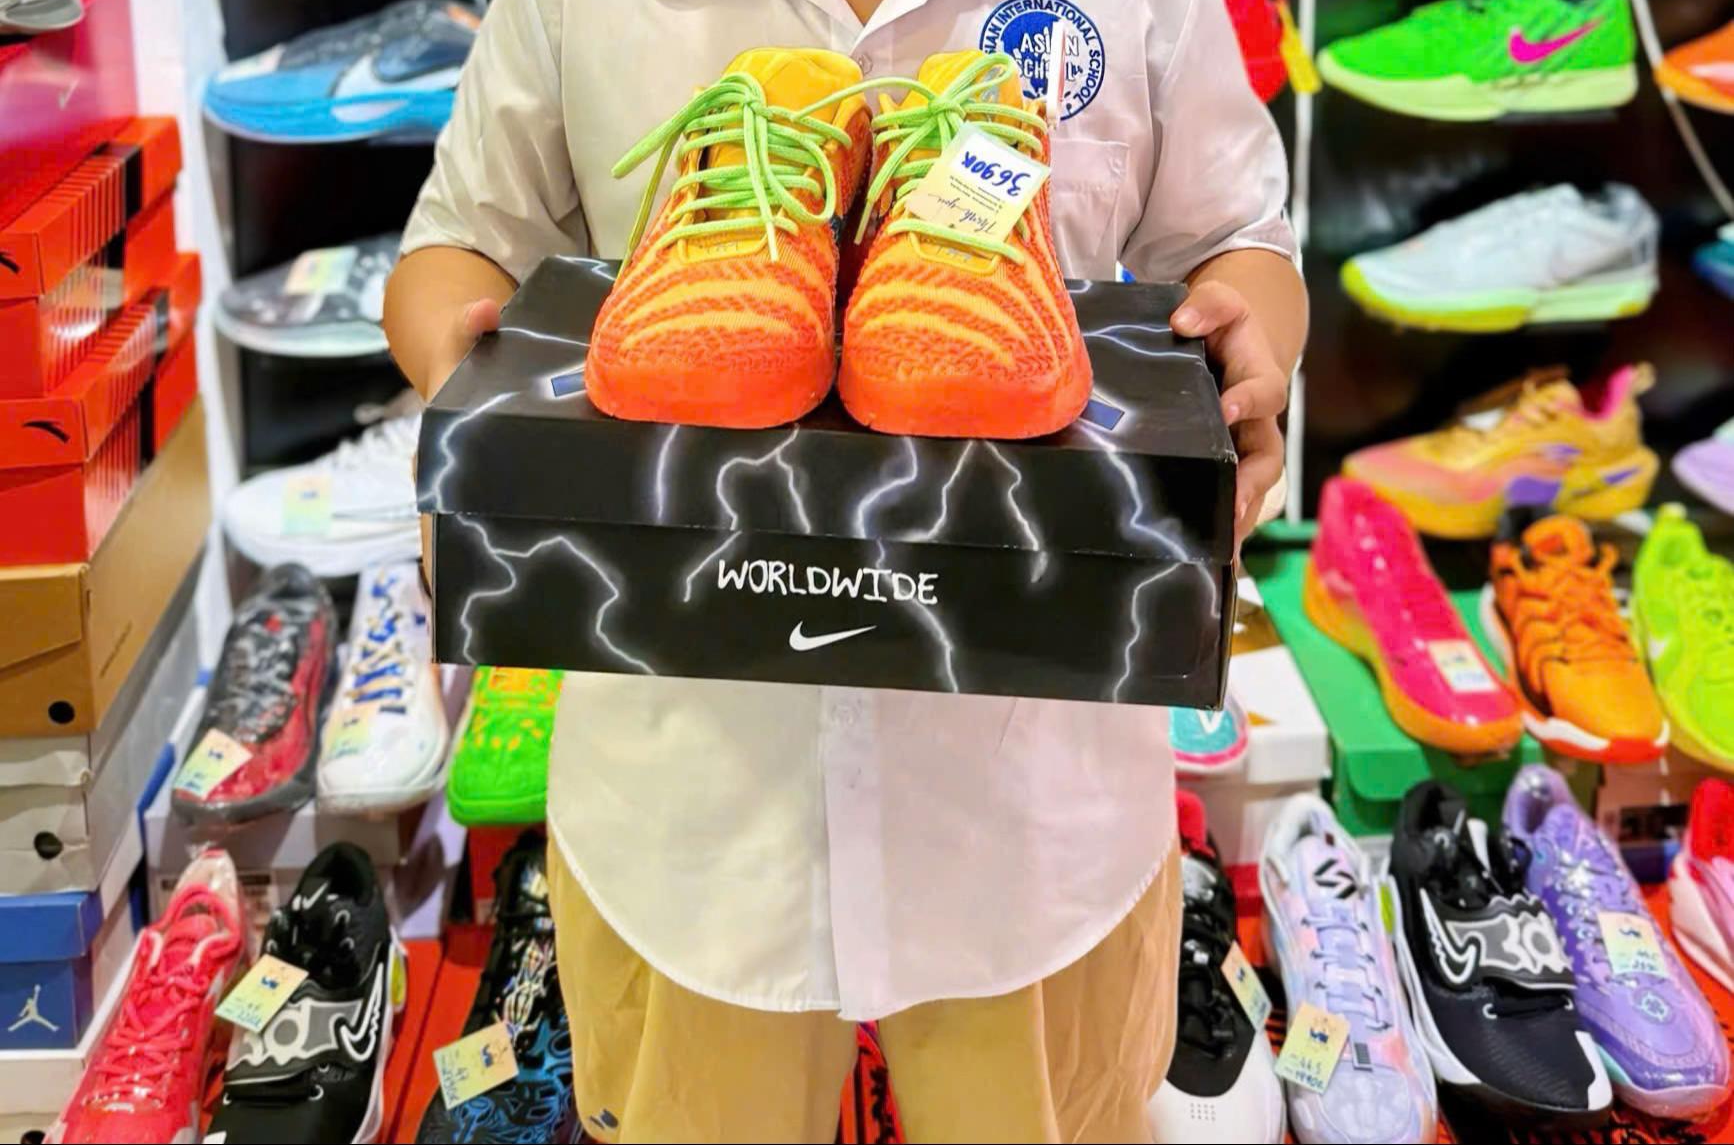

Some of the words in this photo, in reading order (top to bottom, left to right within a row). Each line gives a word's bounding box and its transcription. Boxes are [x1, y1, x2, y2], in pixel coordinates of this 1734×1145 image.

[1020, 30, 1079, 57] ASIN
[1073, 49, 1101, 105] SCHOOL
[961, 151, 1031, 197] 3690K
[717, 558, 939, 605] WORLDWIDE
